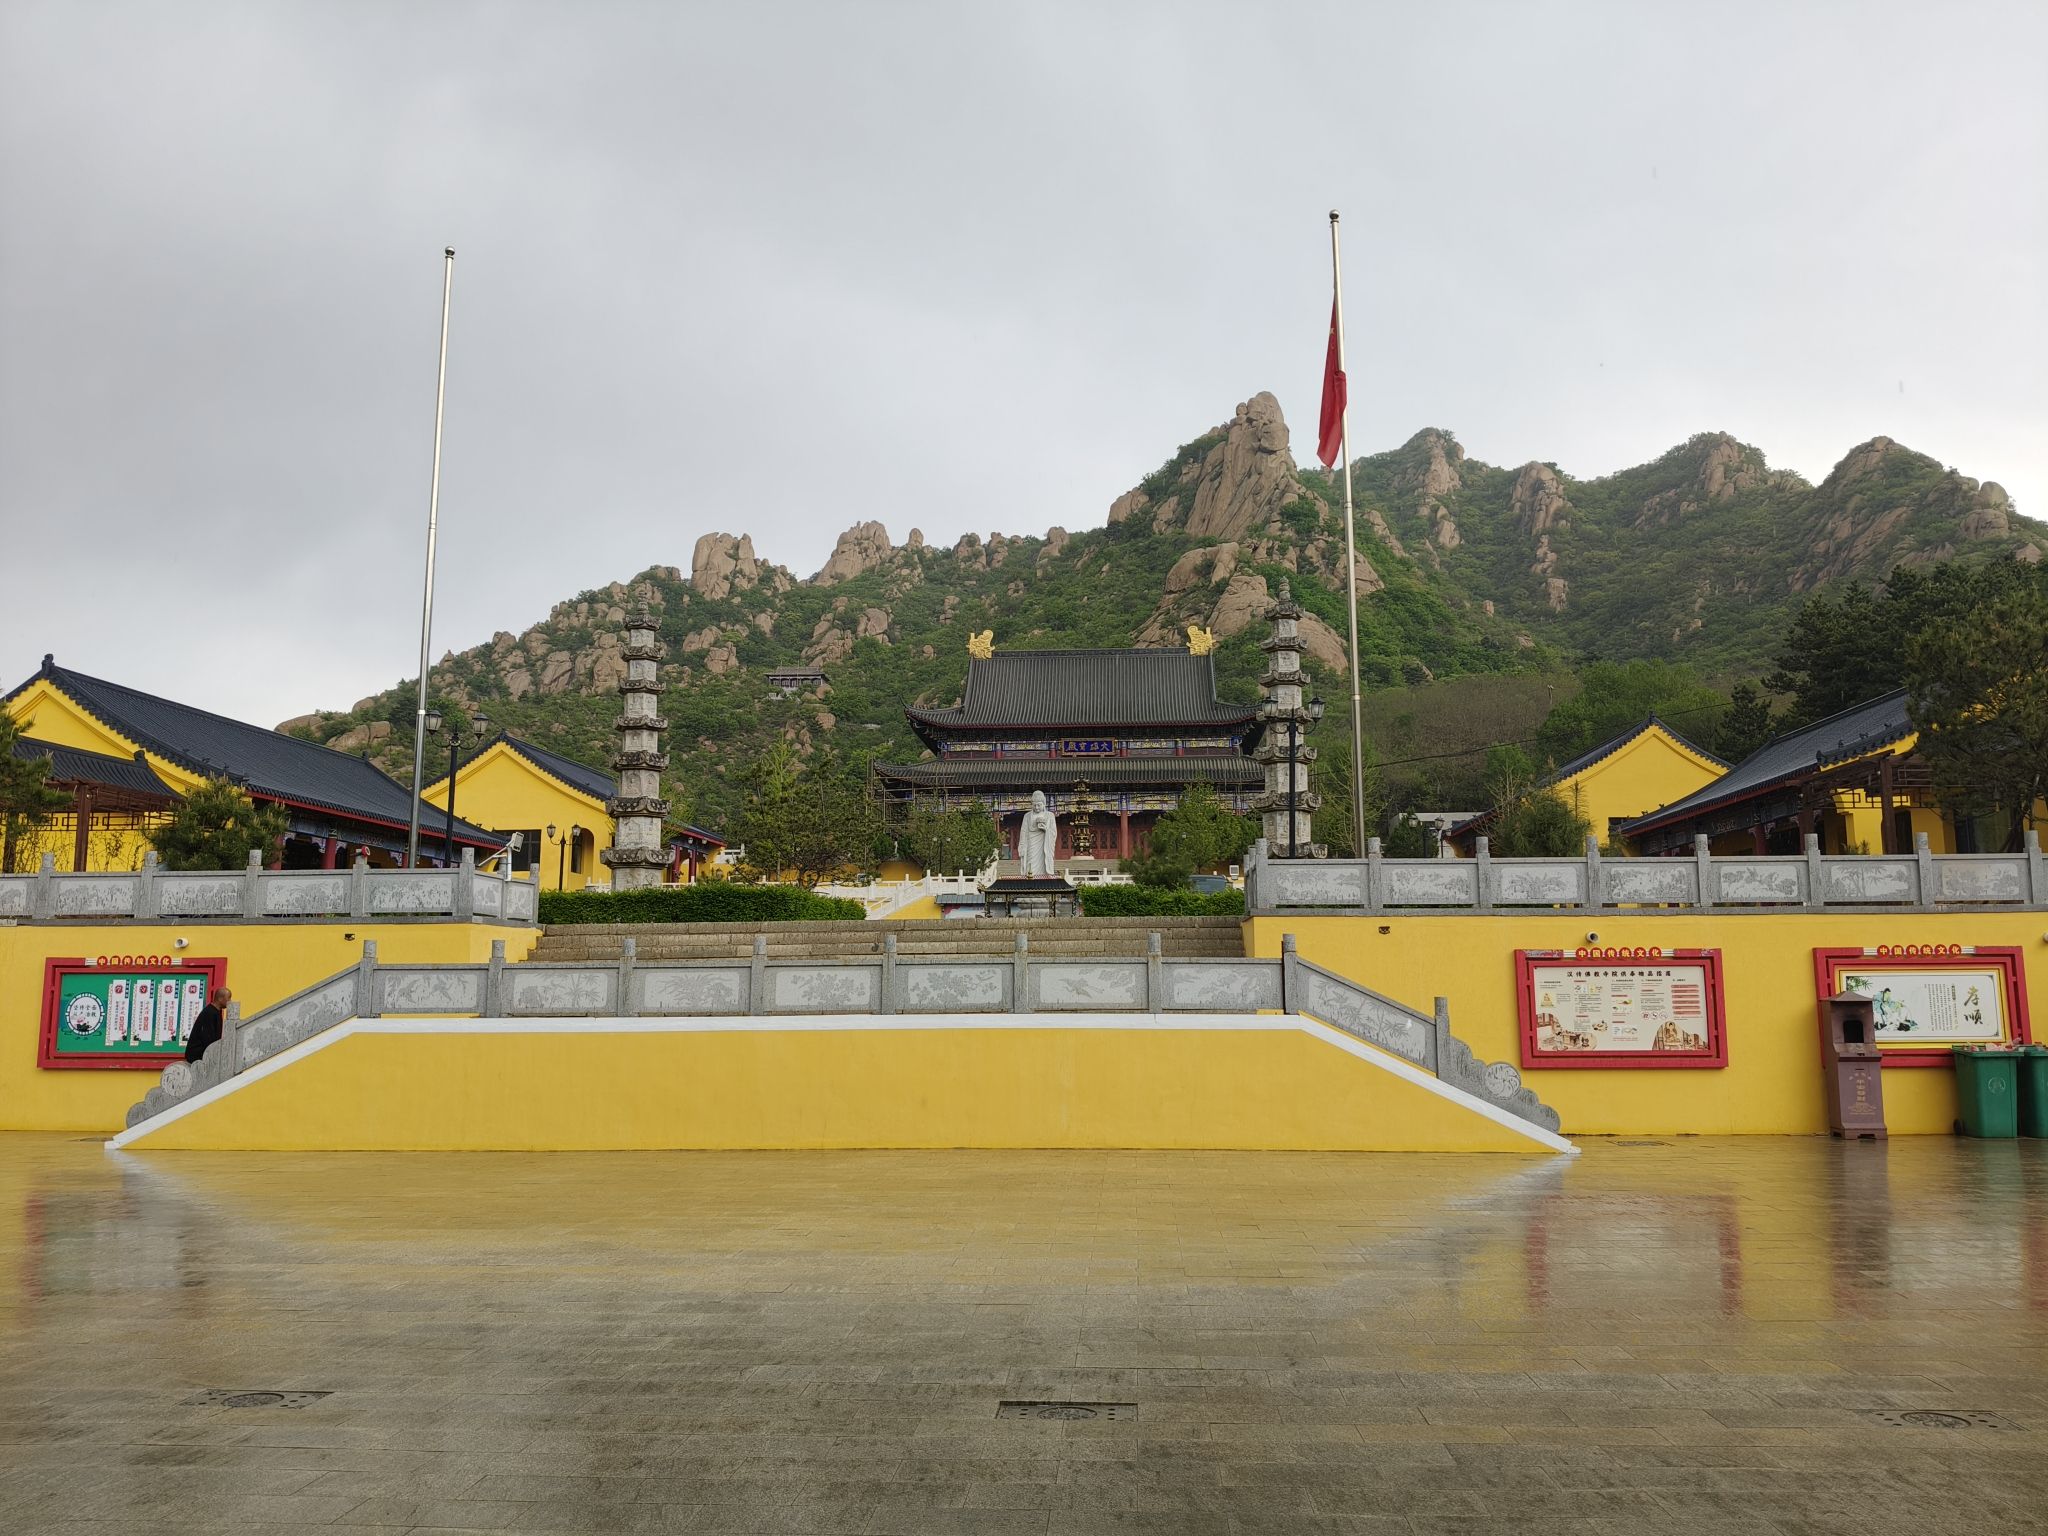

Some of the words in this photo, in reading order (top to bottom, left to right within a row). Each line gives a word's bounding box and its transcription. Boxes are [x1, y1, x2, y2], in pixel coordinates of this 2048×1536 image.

[1578, 948, 1661, 959] 中国传统文化
[1879, 945, 1961, 955] 中国传统文化
[98, 957, 171, 966] 中国传统文化
[1963, 985, 1984, 1025] 孝顺
